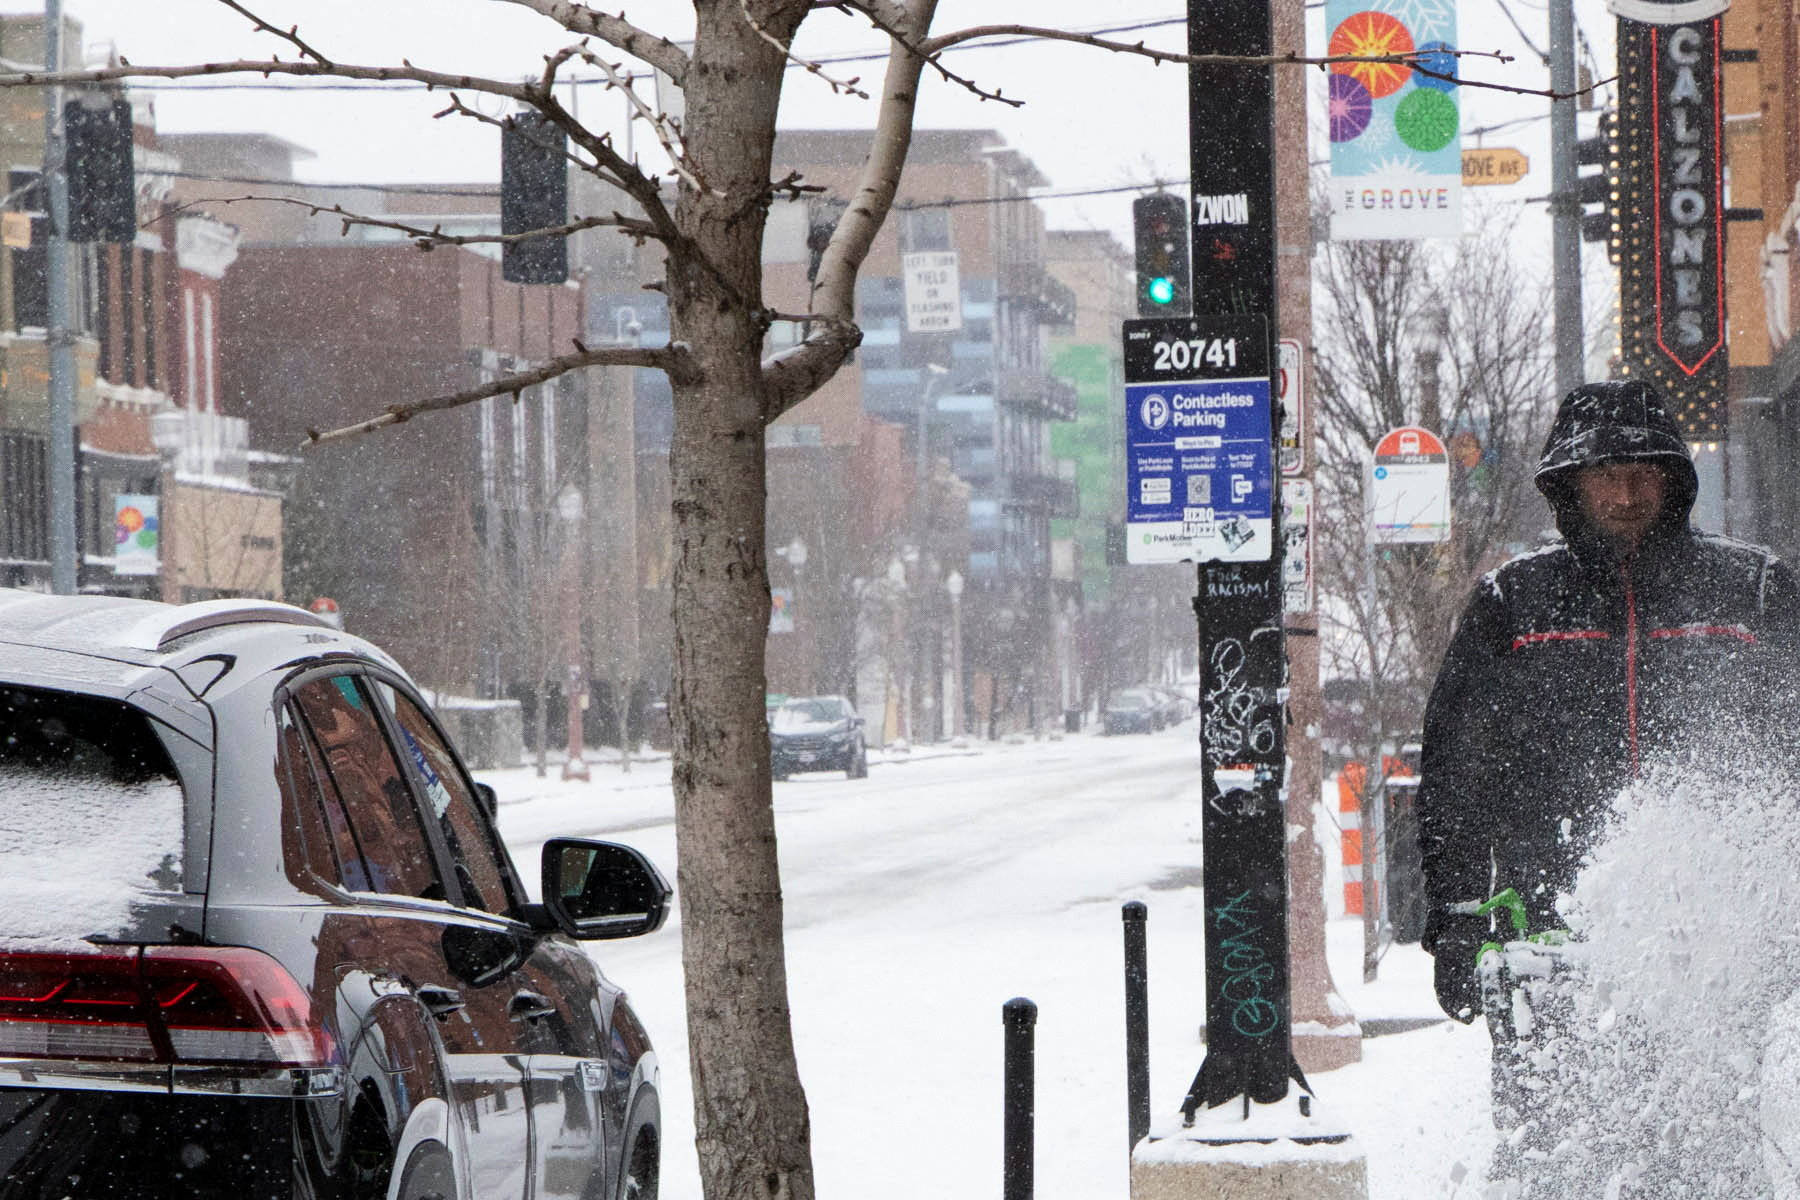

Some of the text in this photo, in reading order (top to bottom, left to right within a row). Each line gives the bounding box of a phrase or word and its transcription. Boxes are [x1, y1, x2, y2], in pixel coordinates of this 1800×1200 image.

[1668, 26, 1706, 347] CALZONES
[1361, 188, 1449, 209] GROVE
[1153, 338, 1237, 370] 20741
[1172, 392, 1254, 410] Contactless
[1173, 411, 1226, 429] Parking
[1207, 580, 1271, 599] RACISM!
